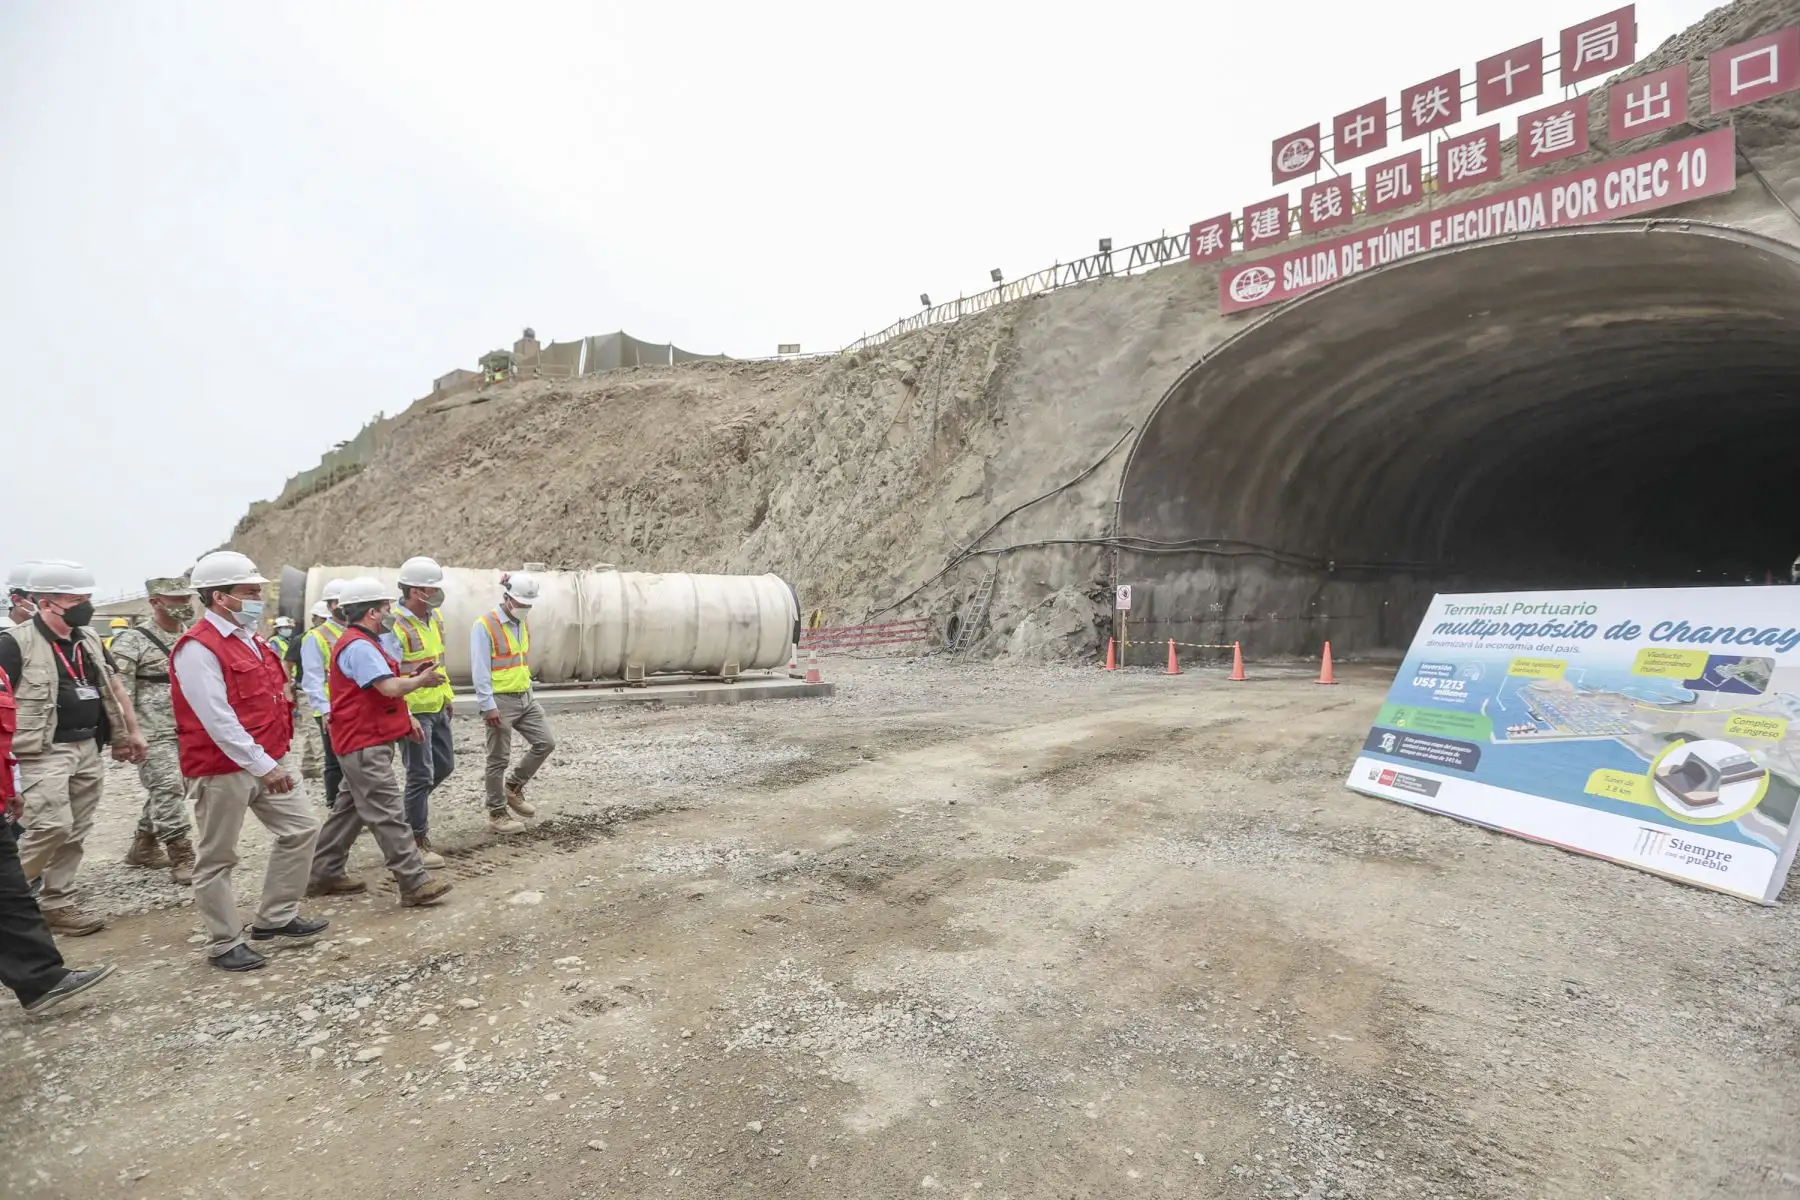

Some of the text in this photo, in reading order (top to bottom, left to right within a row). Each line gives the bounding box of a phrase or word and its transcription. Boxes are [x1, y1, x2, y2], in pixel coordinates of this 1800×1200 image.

[1343, 21, 1619, 149] 中铁十局
[1283, 148, 1707, 291] SALIDA DE TÚNEL EJECUTADA POR CREC 10
[1444, 601, 1597, 616] Terminal Portuario
[1432, 618, 1800, 653] multipropósito de Chancay
[1536, 643, 1553, 652] del
[1733, 716, 1778, 730] Complejo
[1729, 725, 1780, 738] de ingreso
[1669, 838, 1733, 863] Siempre
[1686, 856, 1729, 872] pueblo
